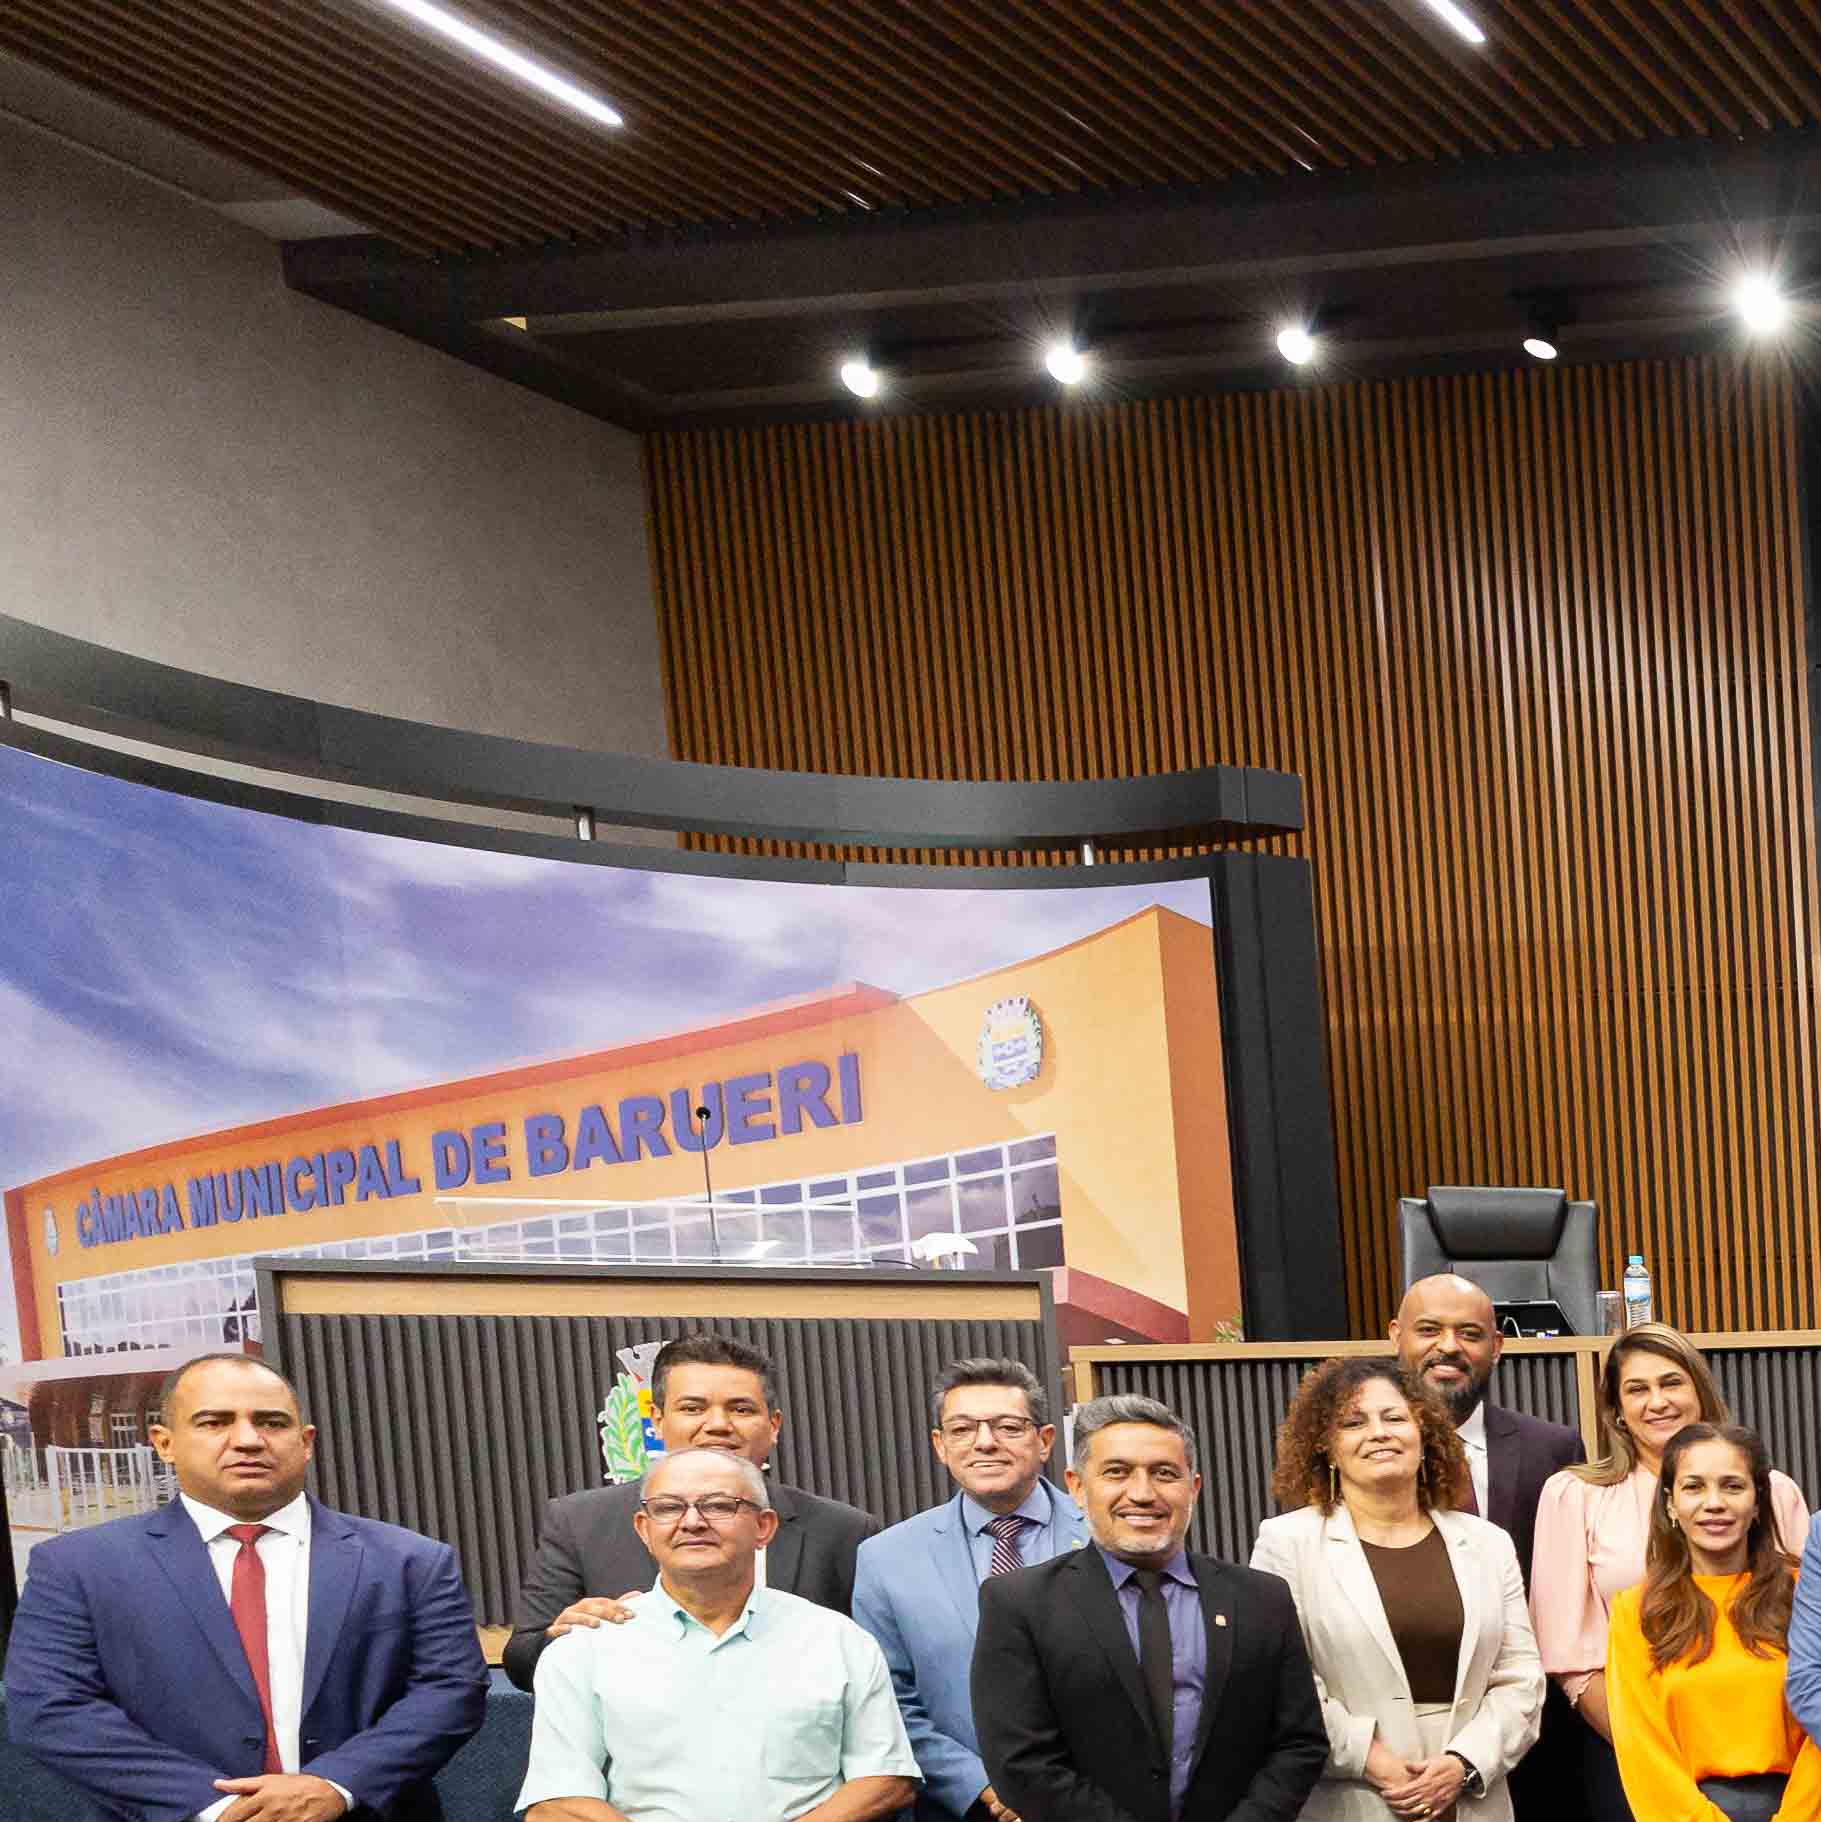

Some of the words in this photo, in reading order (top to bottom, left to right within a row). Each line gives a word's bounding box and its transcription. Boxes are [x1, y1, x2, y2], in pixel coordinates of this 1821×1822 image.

[76, 1188, 185, 1249] CÂMARA
[189, 1138, 423, 1225] MUNICIPAL
[432, 1121, 511, 1190] DE
[523, 1052, 864, 1178] BARUERI
